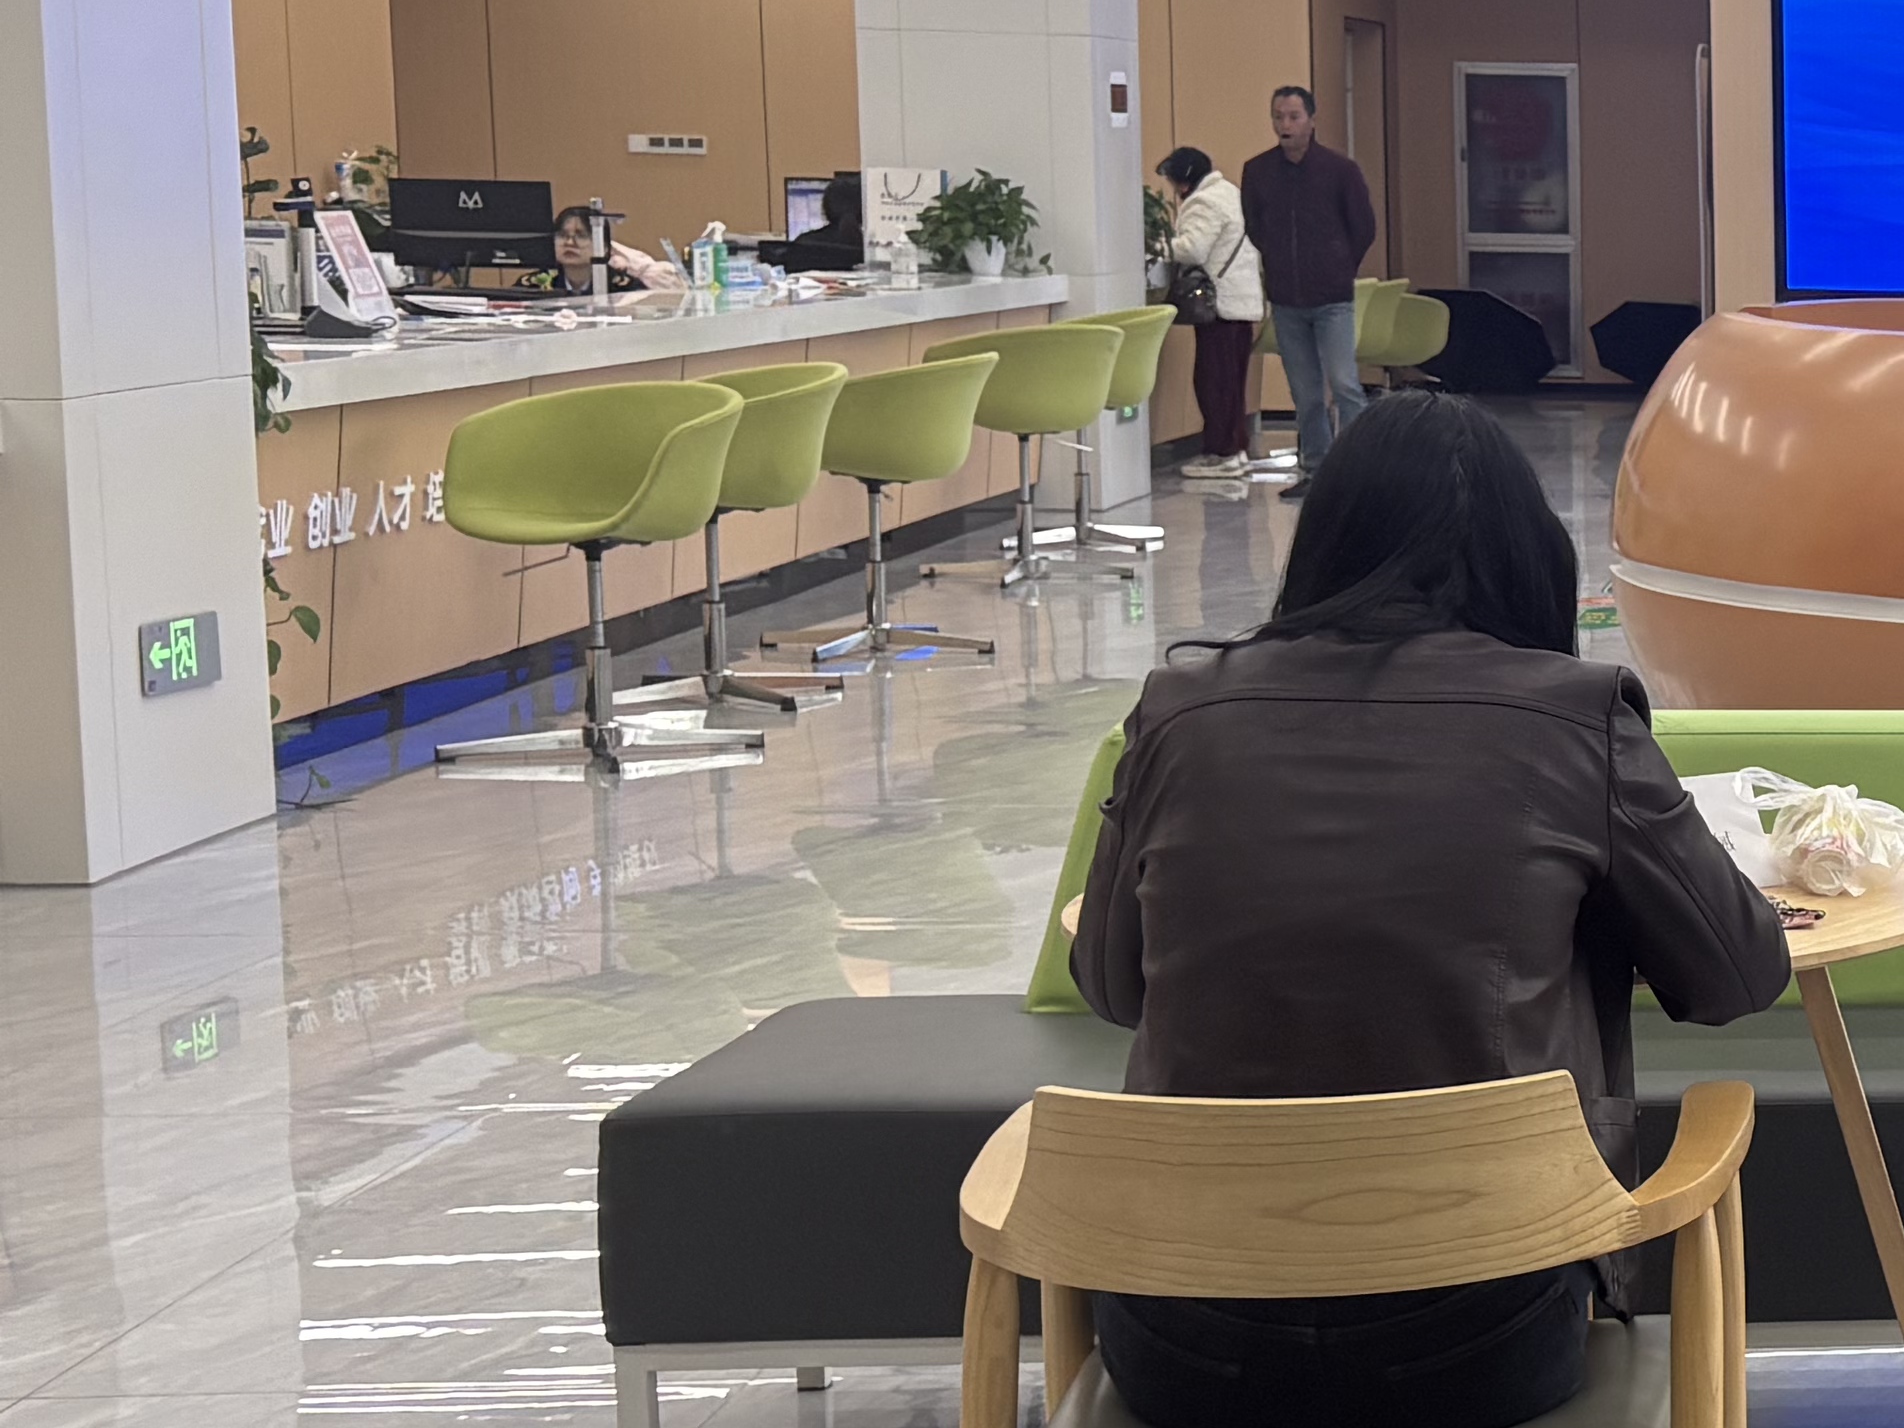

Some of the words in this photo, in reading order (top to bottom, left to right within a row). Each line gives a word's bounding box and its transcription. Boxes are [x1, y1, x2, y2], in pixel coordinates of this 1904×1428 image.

[259, 499, 294, 559] 业
[308, 486, 357, 549] 创业
[367, 474, 415, 536] 人才
